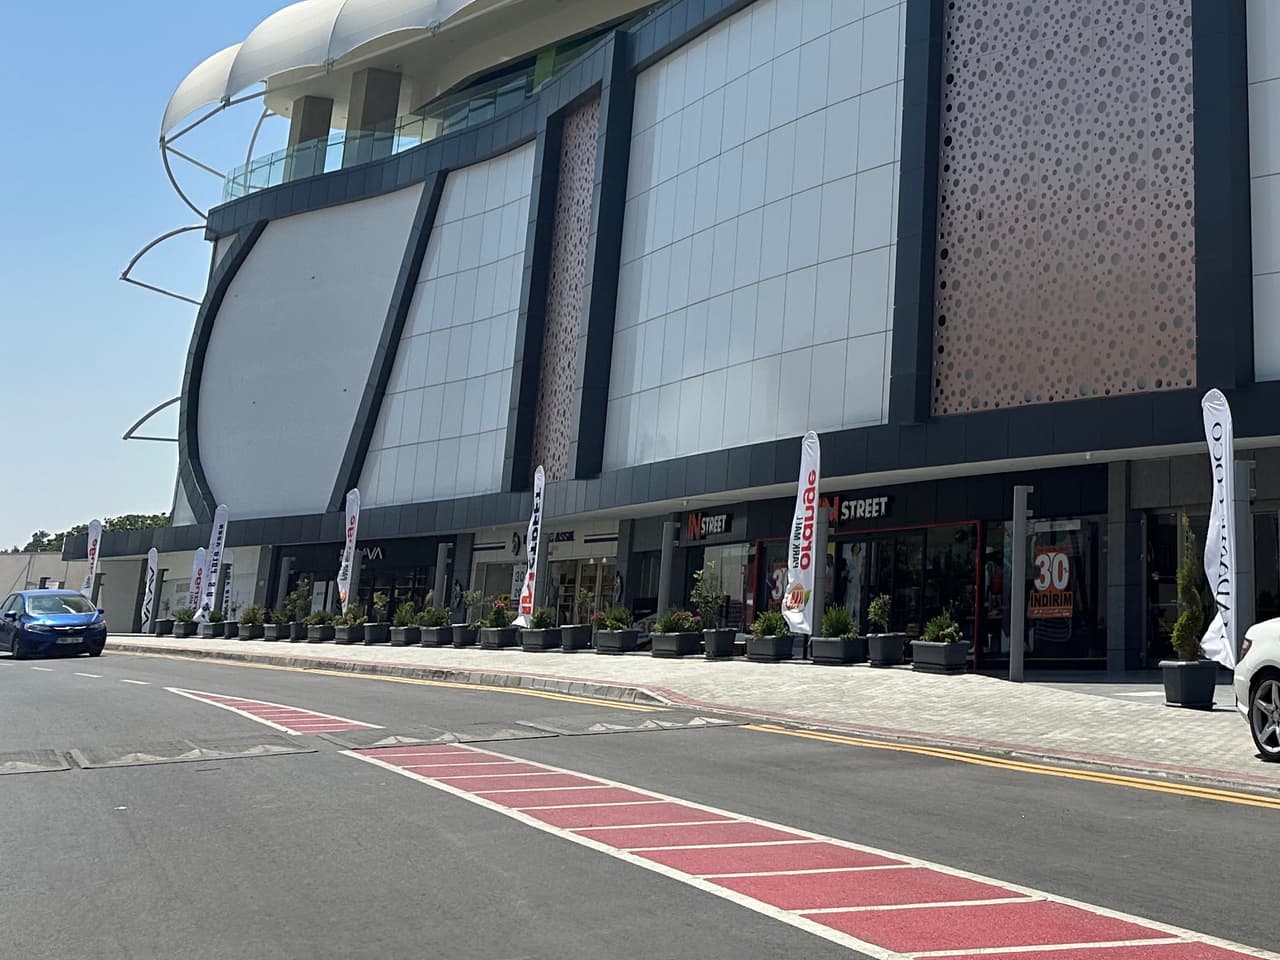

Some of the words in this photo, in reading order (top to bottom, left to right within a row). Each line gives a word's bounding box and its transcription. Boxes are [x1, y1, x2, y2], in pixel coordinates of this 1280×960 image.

[841, 496, 888, 521] STREET
[687, 513, 701, 540] IN
[701, 514, 727, 533] STREET
[1034, 553, 1070, 591] 30
